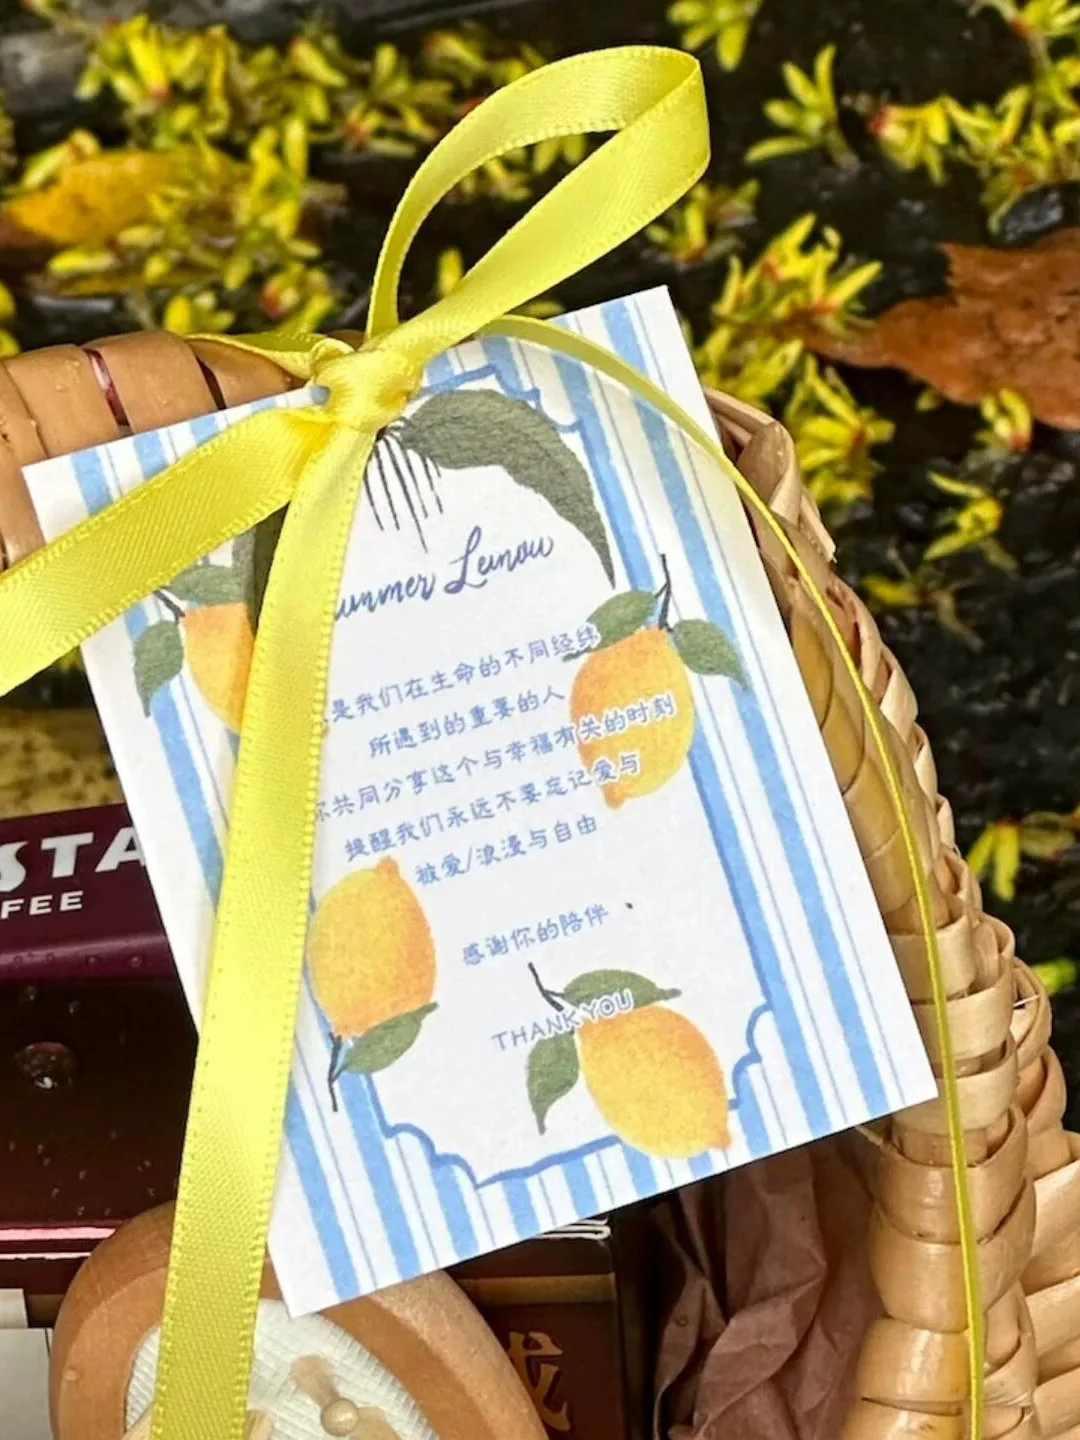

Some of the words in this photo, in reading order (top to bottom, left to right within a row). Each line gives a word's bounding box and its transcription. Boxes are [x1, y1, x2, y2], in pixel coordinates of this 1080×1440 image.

[332, 572, 436, 621] ummer
[323, 624, 600, 724] 是我们在生命的不同经纬
[369, 685, 566, 758] 所遇到的重要的人
[345, 753, 639, 863] 提醒我们永远不要忘记爱与
[462, 903, 609, 965] 感谢你的陪伴
[491, 1009, 580, 1051] THANK
[582, 989, 634, 1020] YOU
